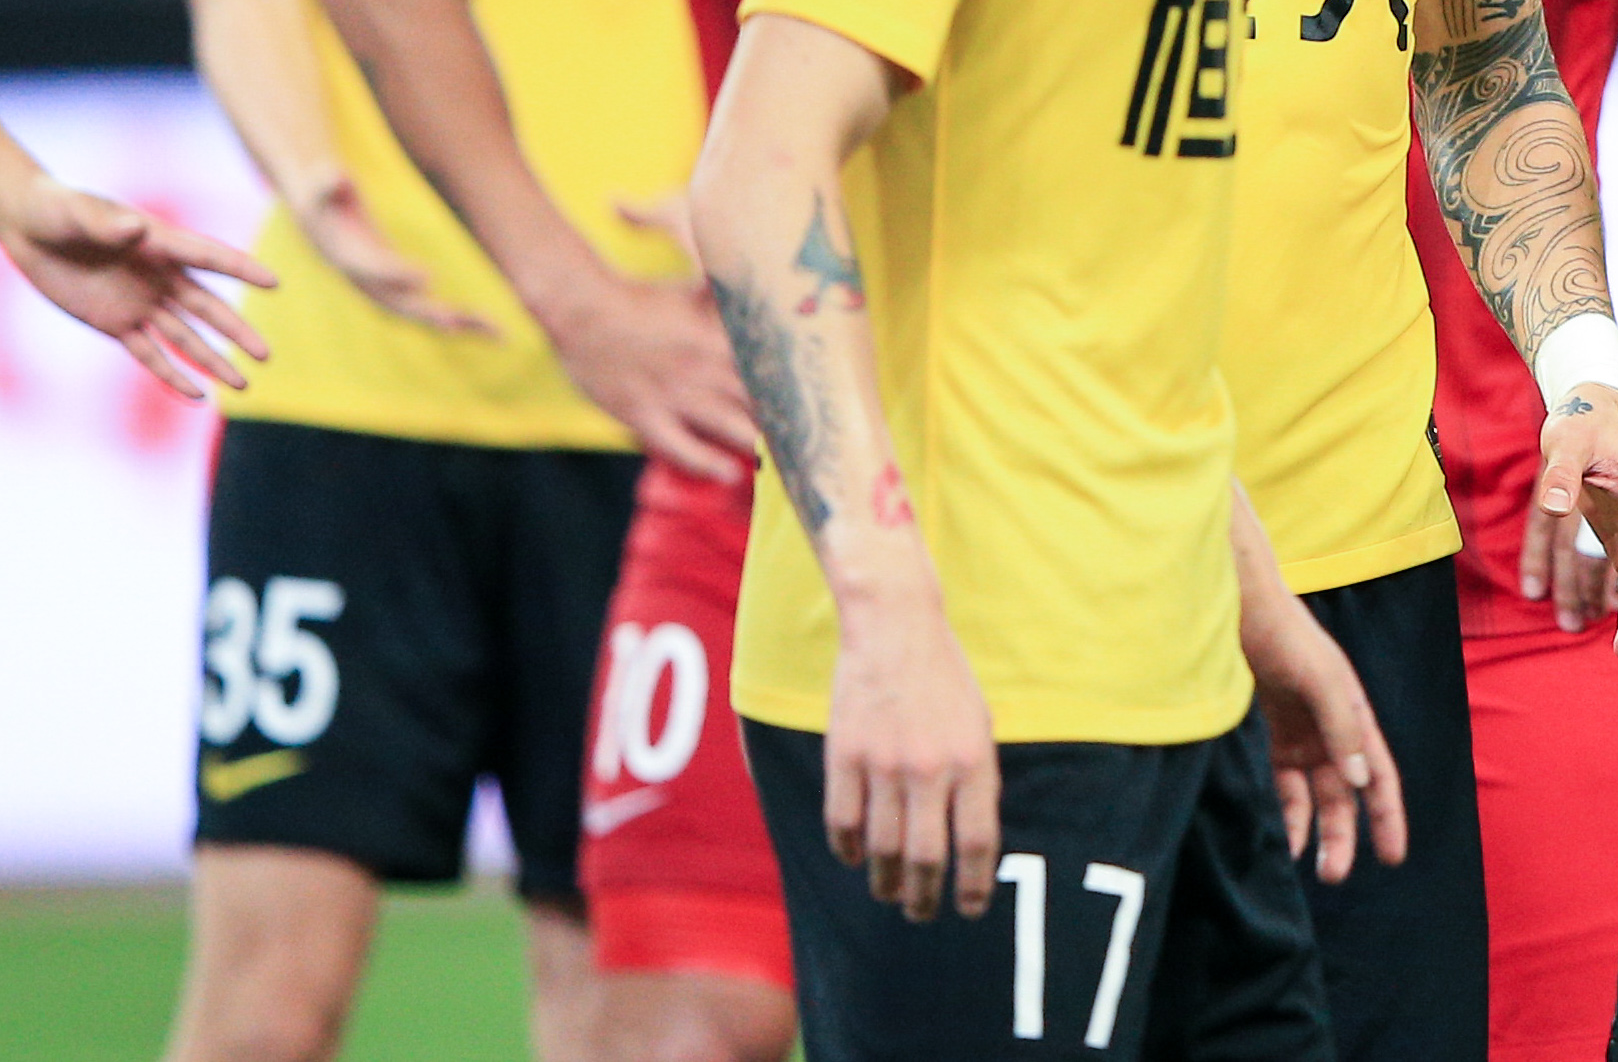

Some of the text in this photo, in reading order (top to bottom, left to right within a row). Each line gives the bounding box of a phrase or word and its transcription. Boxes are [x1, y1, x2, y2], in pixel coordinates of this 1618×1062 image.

[201, 574, 346, 746] 35
[592, 621, 710, 784] 10
[995, 852, 1146, 1050] 17
